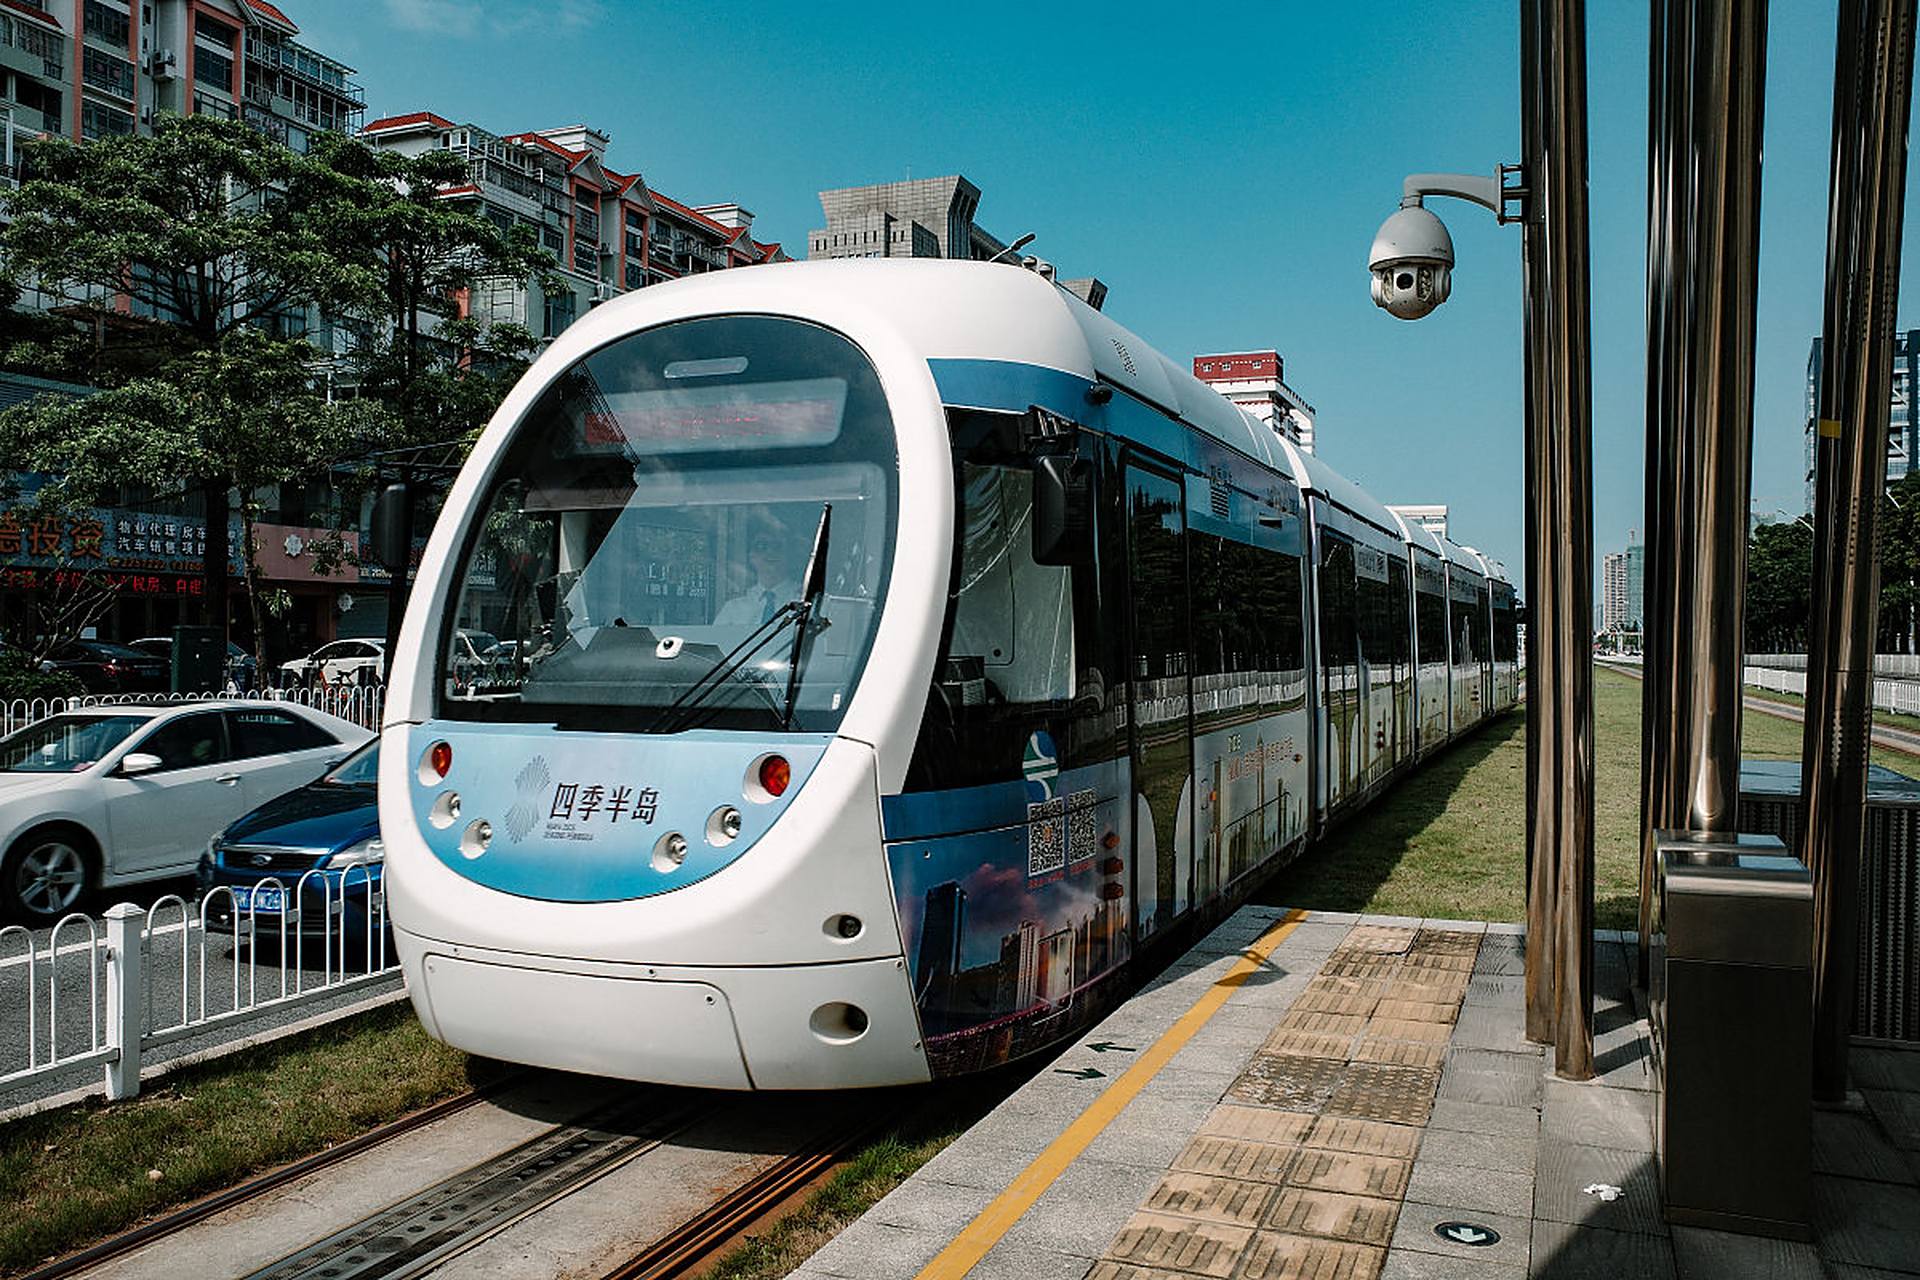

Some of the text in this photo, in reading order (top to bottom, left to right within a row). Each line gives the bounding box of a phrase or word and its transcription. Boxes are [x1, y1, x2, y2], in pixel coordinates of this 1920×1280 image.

[118, 519, 176, 537] 物业代理
[118, 537, 176, 555] 汽车销售
[550, 782, 660, 825] 四季半岛
